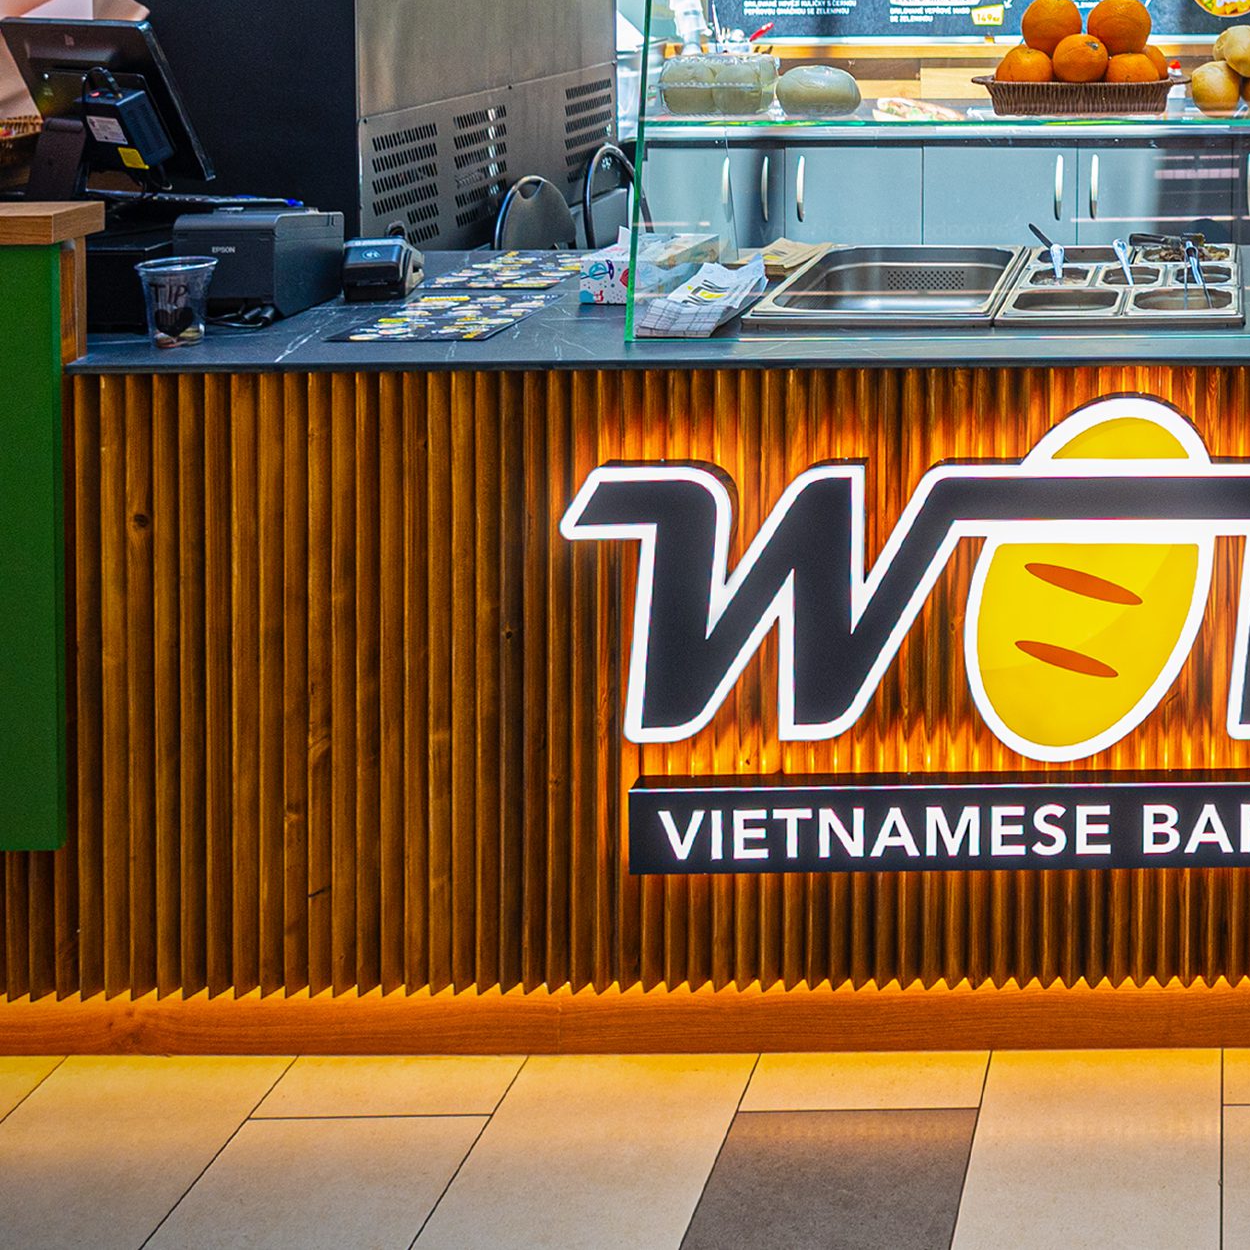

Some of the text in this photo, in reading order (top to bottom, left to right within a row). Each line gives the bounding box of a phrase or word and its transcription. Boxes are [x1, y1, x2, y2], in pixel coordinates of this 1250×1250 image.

[211, 246, 236, 254] EPSON
[149, 283, 187, 304] TIP
[658, 806, 1112, 861] VIETNAMESE
